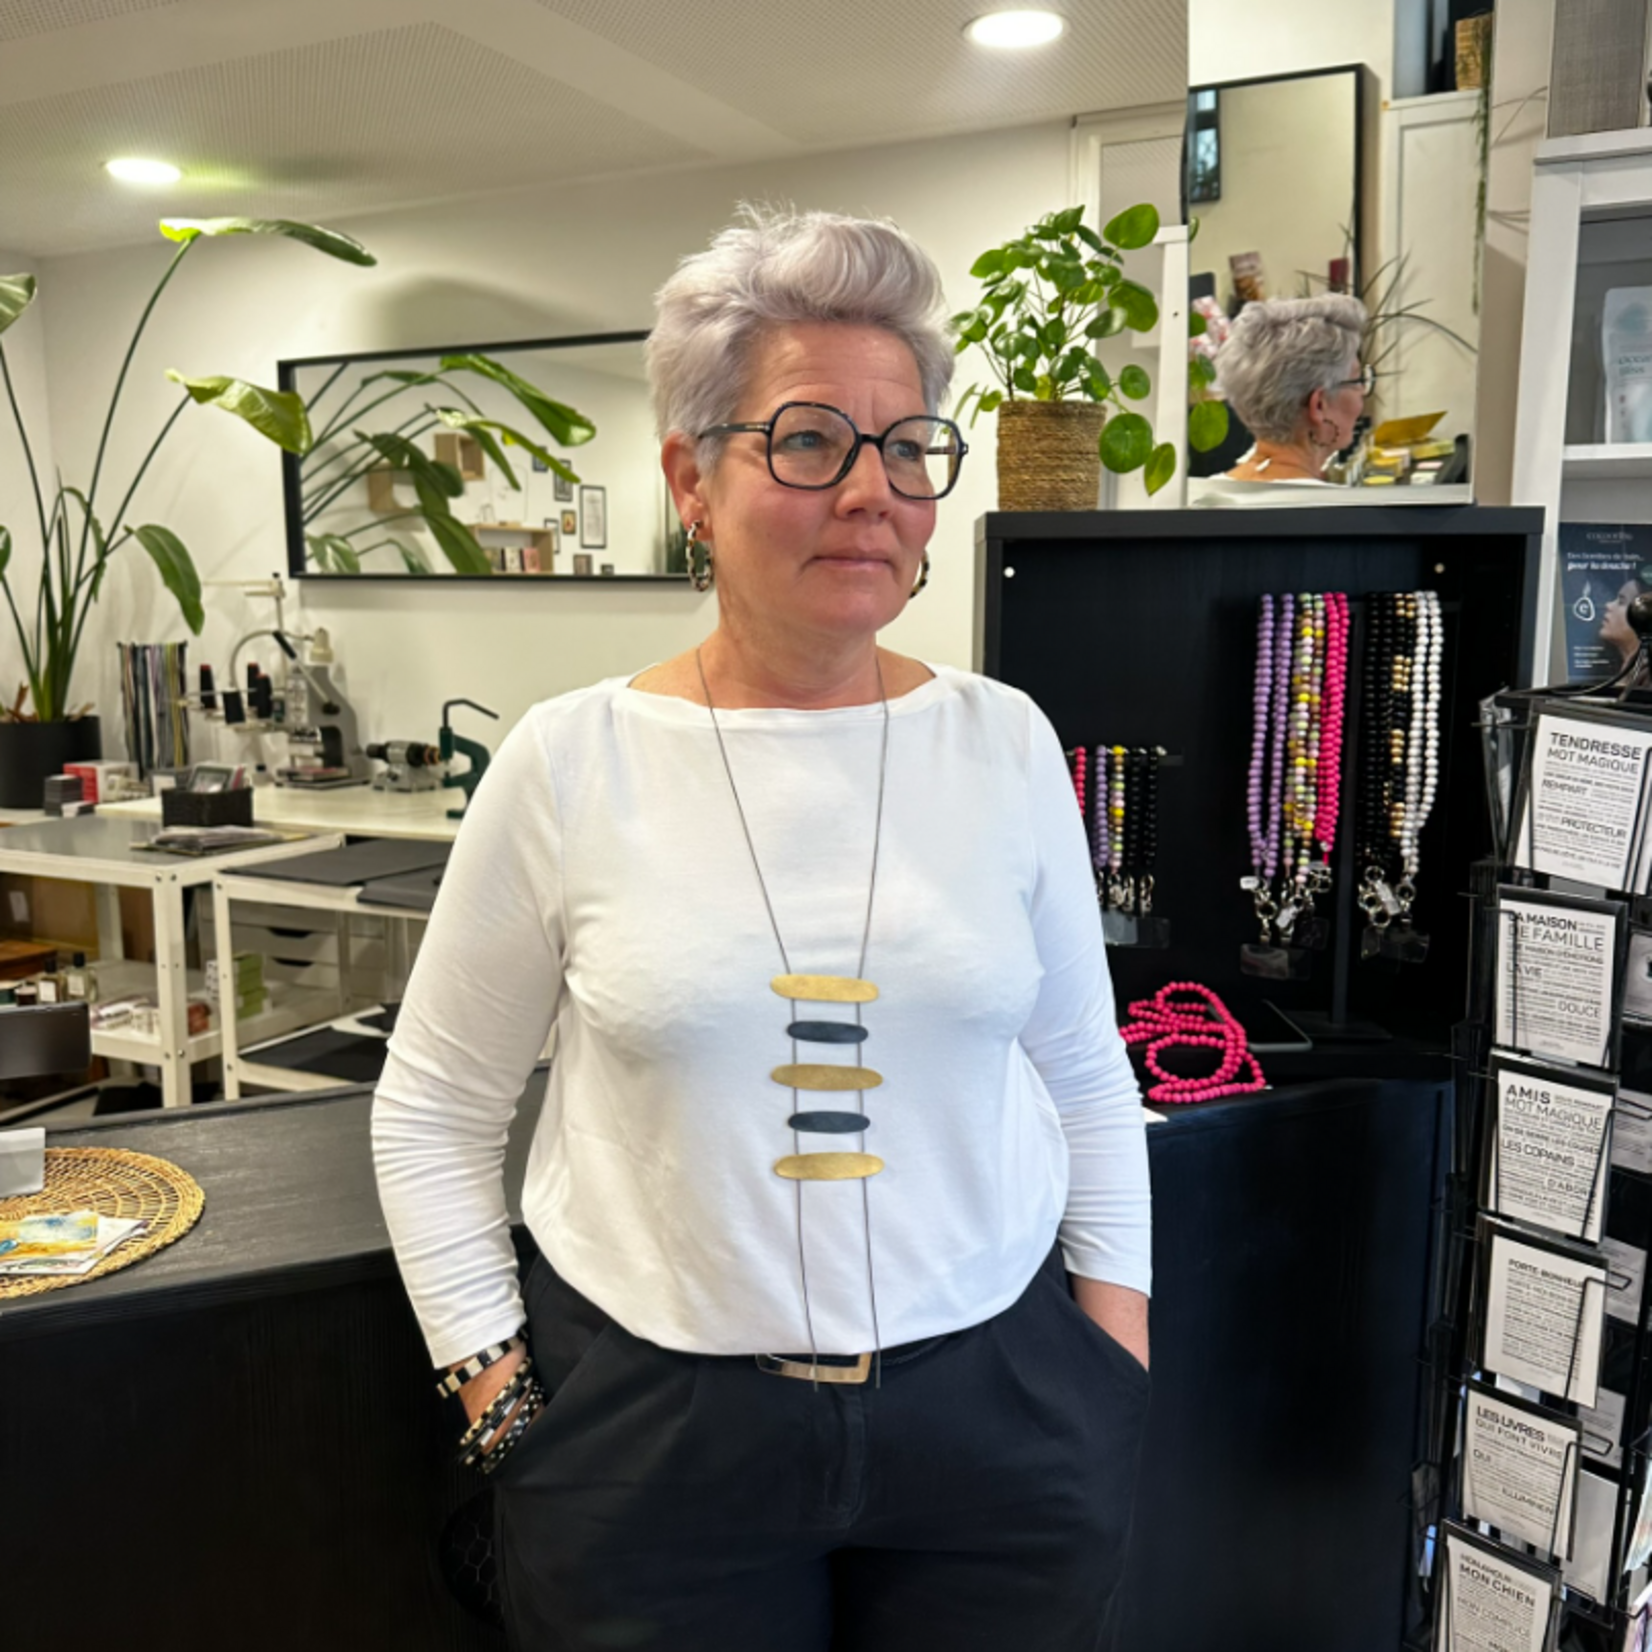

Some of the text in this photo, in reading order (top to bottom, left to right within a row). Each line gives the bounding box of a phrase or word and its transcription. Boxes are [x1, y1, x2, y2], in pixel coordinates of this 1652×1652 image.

[1548, 732, 1642, 760] TENDRESSE
[1547, 747, 1576, 762] MOT
[1577, 753, 1639, 775] MAGIQUE
[1561, 816, 1627, 839] PROTECTEUR
[1526, 913, 1577, 931] MAISON
[1533, 926, 1604, 952] FAMILLE
[1558, 1000, 1601, 1018] DOUCE
[1506, 1084, 1551, 1104] AMIS
[1505, 1097, 1534, 1112] MOT
[1537, 1105, 1602, 1131] MAGIQUE
[1503, 1139, 1575, 1166] LES COPAINS
[1477, 1405, 1545, 1442] LES LIVRES
[1460, 1563, 1490, 1584] MON
[1492, 1579, 1536, 1607] CHIEN
